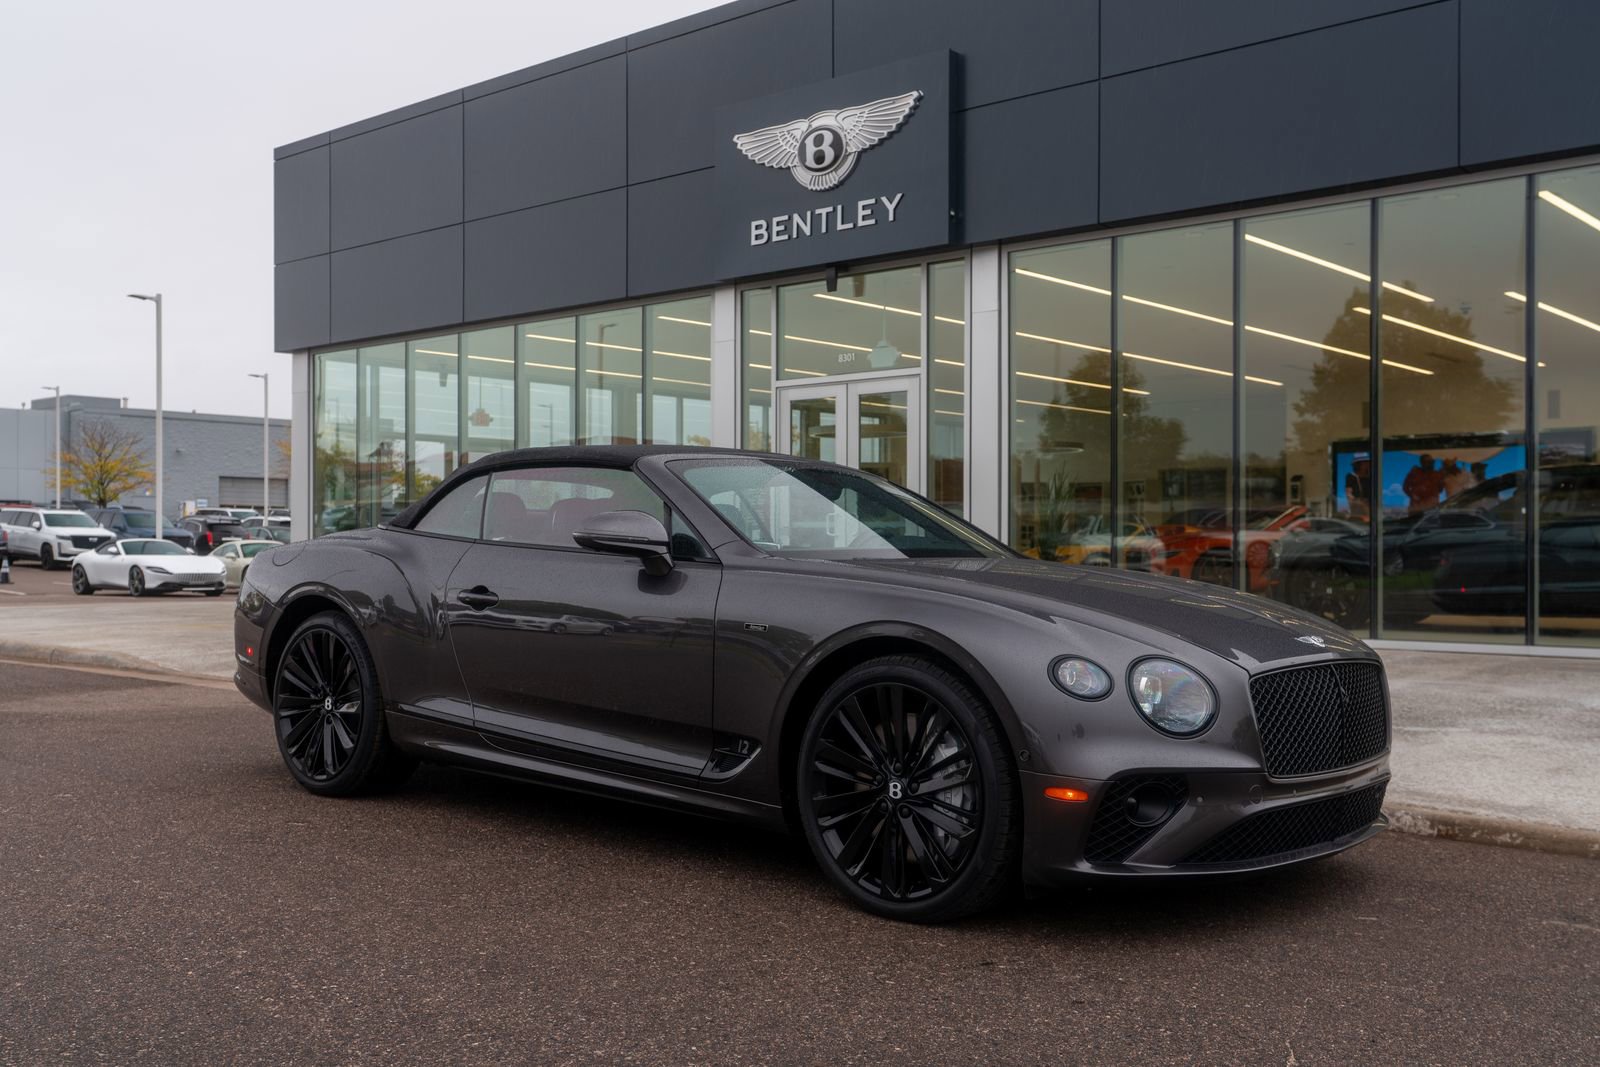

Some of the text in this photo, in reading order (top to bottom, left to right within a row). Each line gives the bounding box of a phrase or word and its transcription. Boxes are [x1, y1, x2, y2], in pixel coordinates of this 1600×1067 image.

[804, 131, 836, 168] B
[750, 193, 904, 246] BENTLEY
[838, 352, 855, 363] 8301
[738, 738, 749, 754] 12
[888, 782, 903, 800] B
